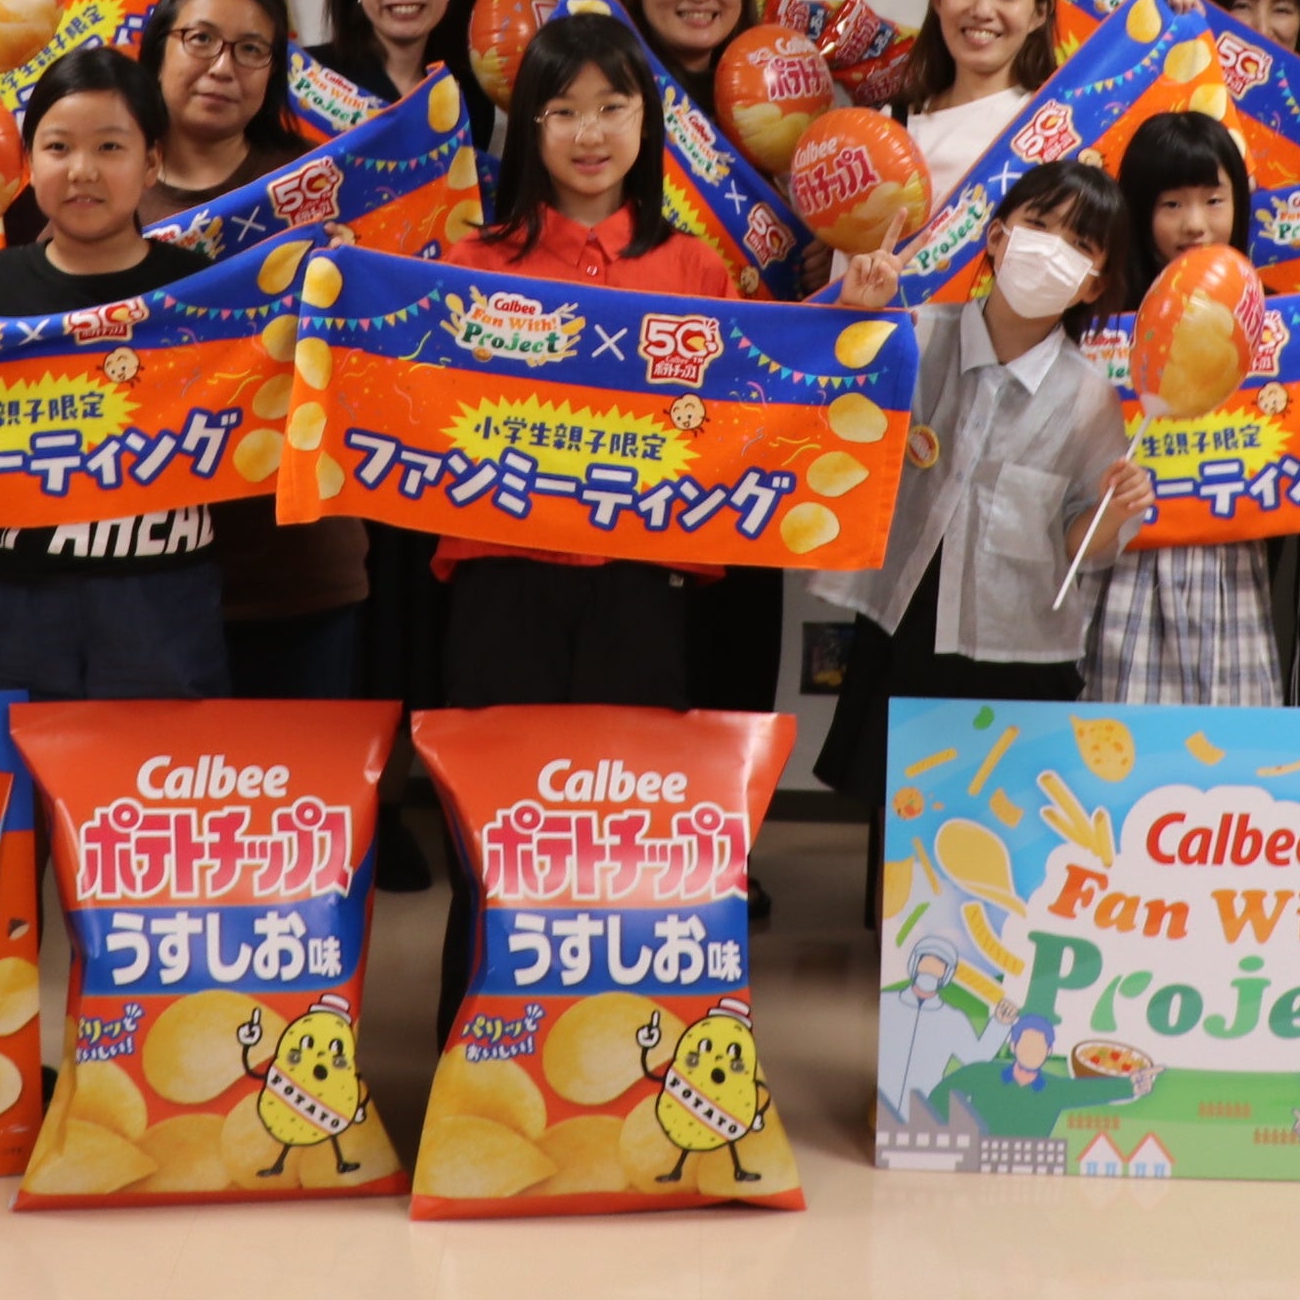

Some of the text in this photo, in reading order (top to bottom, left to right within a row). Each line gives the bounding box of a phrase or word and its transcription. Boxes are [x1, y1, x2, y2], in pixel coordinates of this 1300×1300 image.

[472, 308, 557, 335] Fan With!
[493, 297, 537, 318] Calbee
[461, 325, 560, 356] Project
[645, 322, 713, 359] 50
[473, 416, 668, 463] 小学生親子限定
[346, 430, 795, 538] ファンミーティング
[136, 755, 290, 800] Calbee
[536, 758, 688, 803] Calbee
[76, 796, 355, 901] ポテトチップス
[482, 799, 750, 901] ポテトチップス
[1047, 863, 1192, 940] Fan
[105, 910, 343, 986] うすしお味
[507, 913, 743, 987] うすしお味
[270, 1072, 342, 1132] POTATO
[668, 1076, 740, 1137] POTATO
